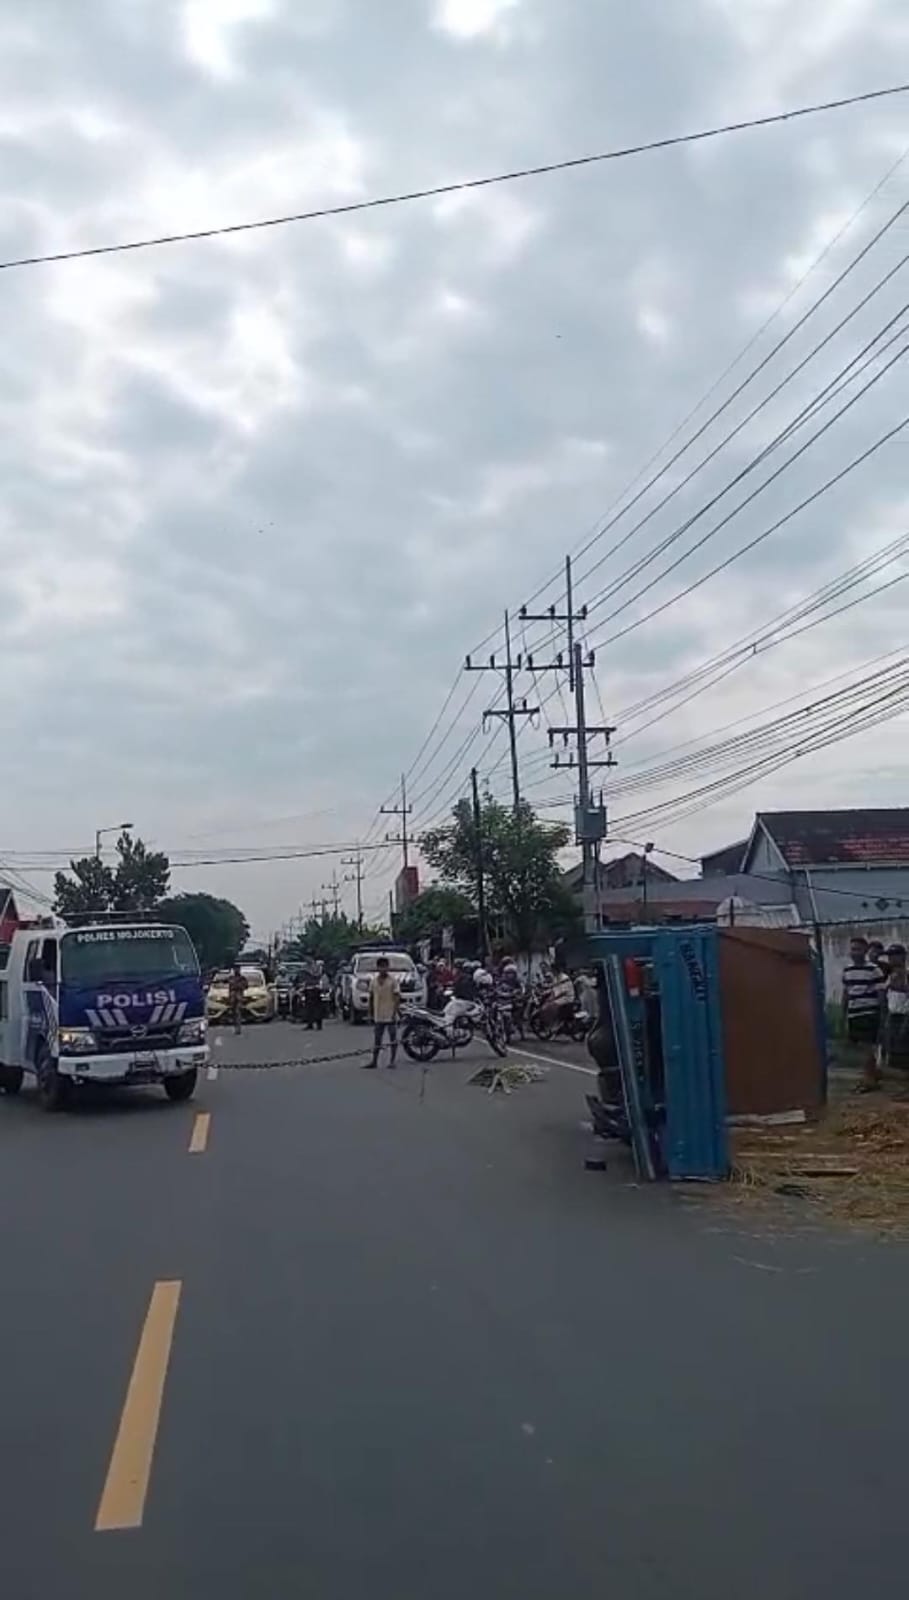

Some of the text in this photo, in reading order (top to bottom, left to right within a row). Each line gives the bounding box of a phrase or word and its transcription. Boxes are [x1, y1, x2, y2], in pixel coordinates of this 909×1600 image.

[77, 929, 174, 943] POLRES MOJOKERTO
[97, 989, 176, 1008] POLISI
